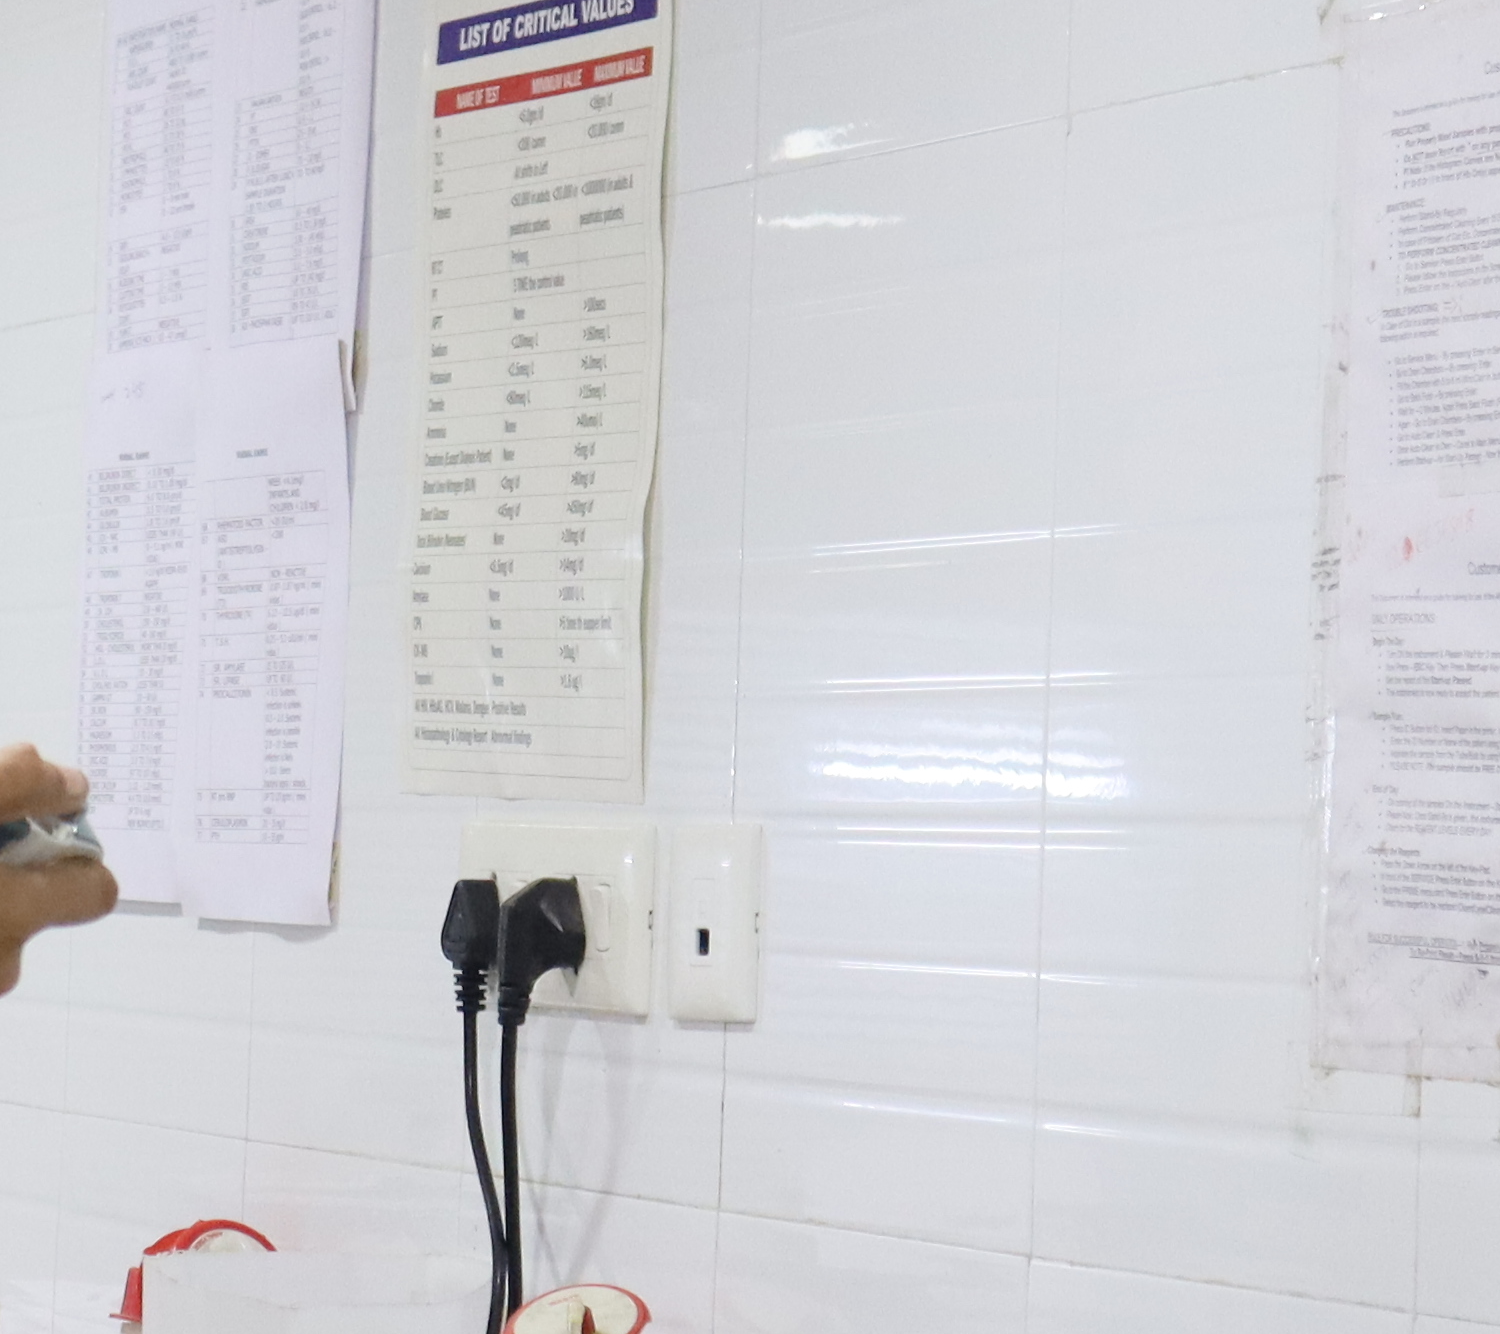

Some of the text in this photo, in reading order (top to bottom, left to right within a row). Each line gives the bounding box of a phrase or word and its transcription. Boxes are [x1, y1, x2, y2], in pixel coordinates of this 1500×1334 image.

[459, 23, 487, 51] LIST
[493, 15, 512, 42] OF
[514, 3, 579, 39] CRITICAL
